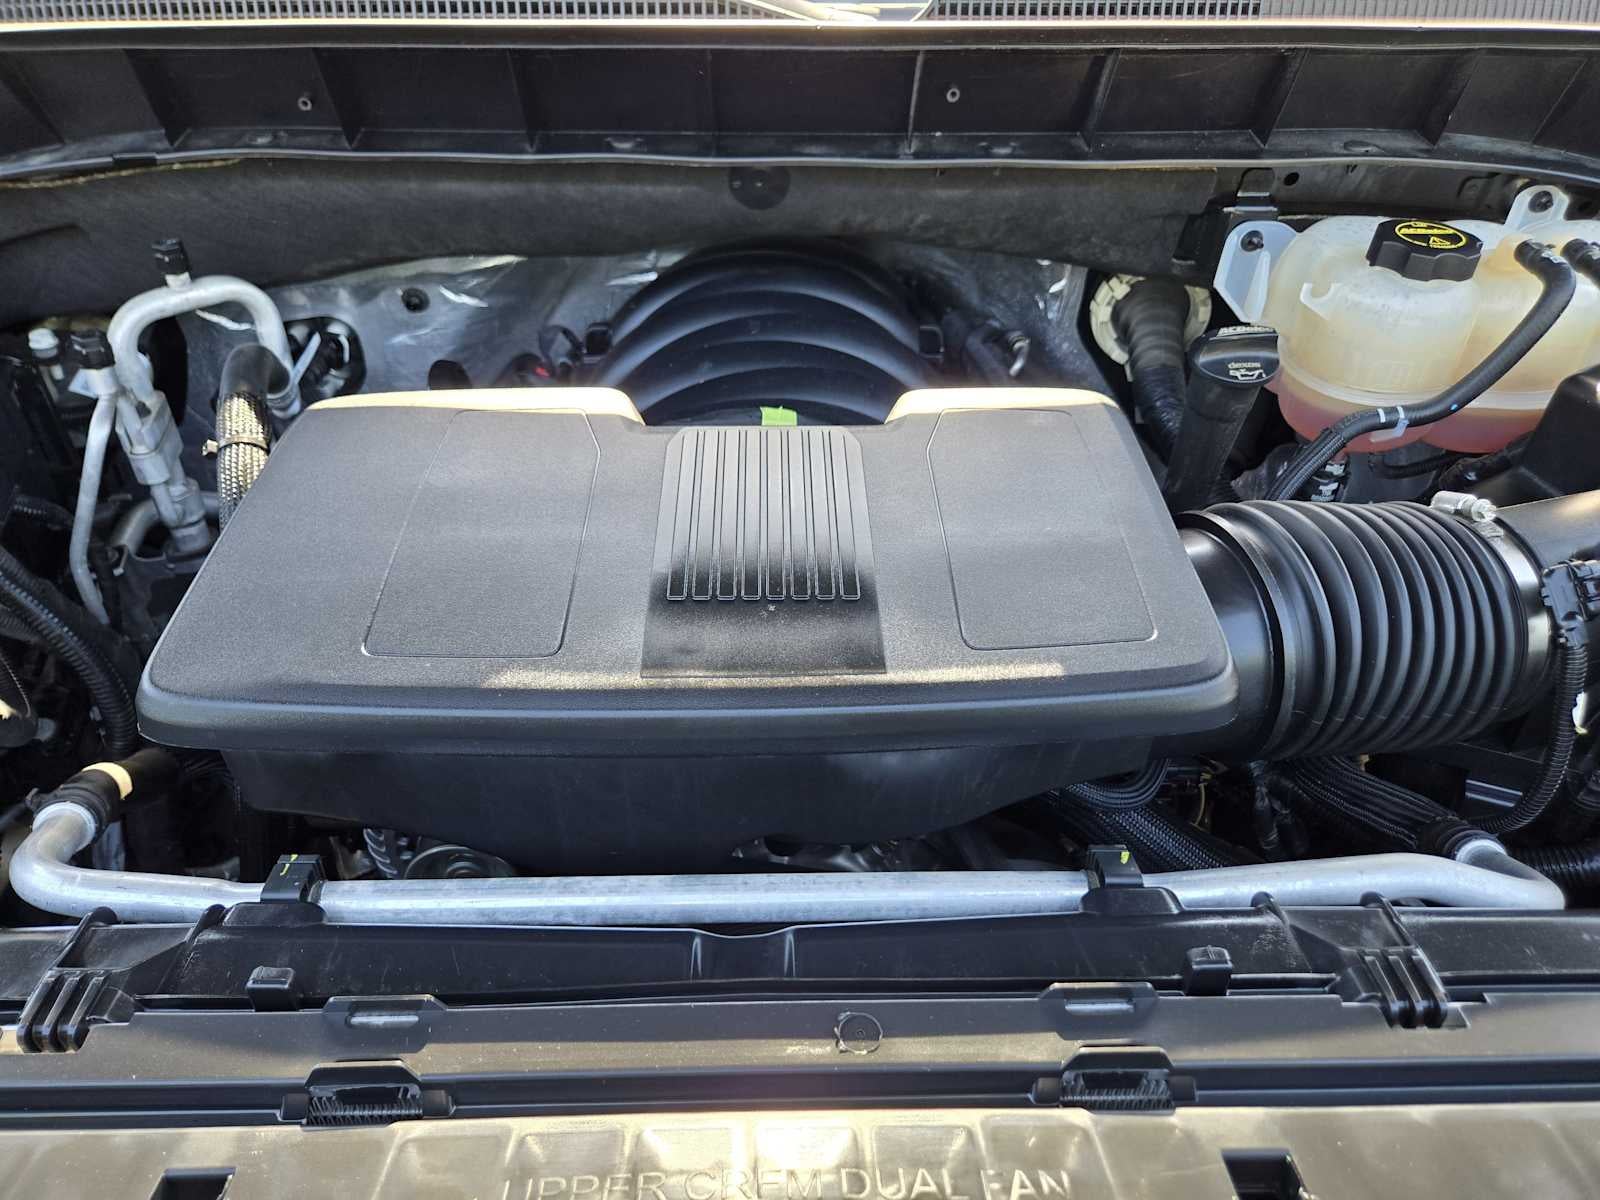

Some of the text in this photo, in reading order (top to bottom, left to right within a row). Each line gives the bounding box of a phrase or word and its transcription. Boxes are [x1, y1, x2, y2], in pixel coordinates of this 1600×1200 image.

[501, 1171, 668, 1200] UPPER
[840, 1167, 969, 1200] DUAL
[980, 1168, 1071, 1200] FAN
